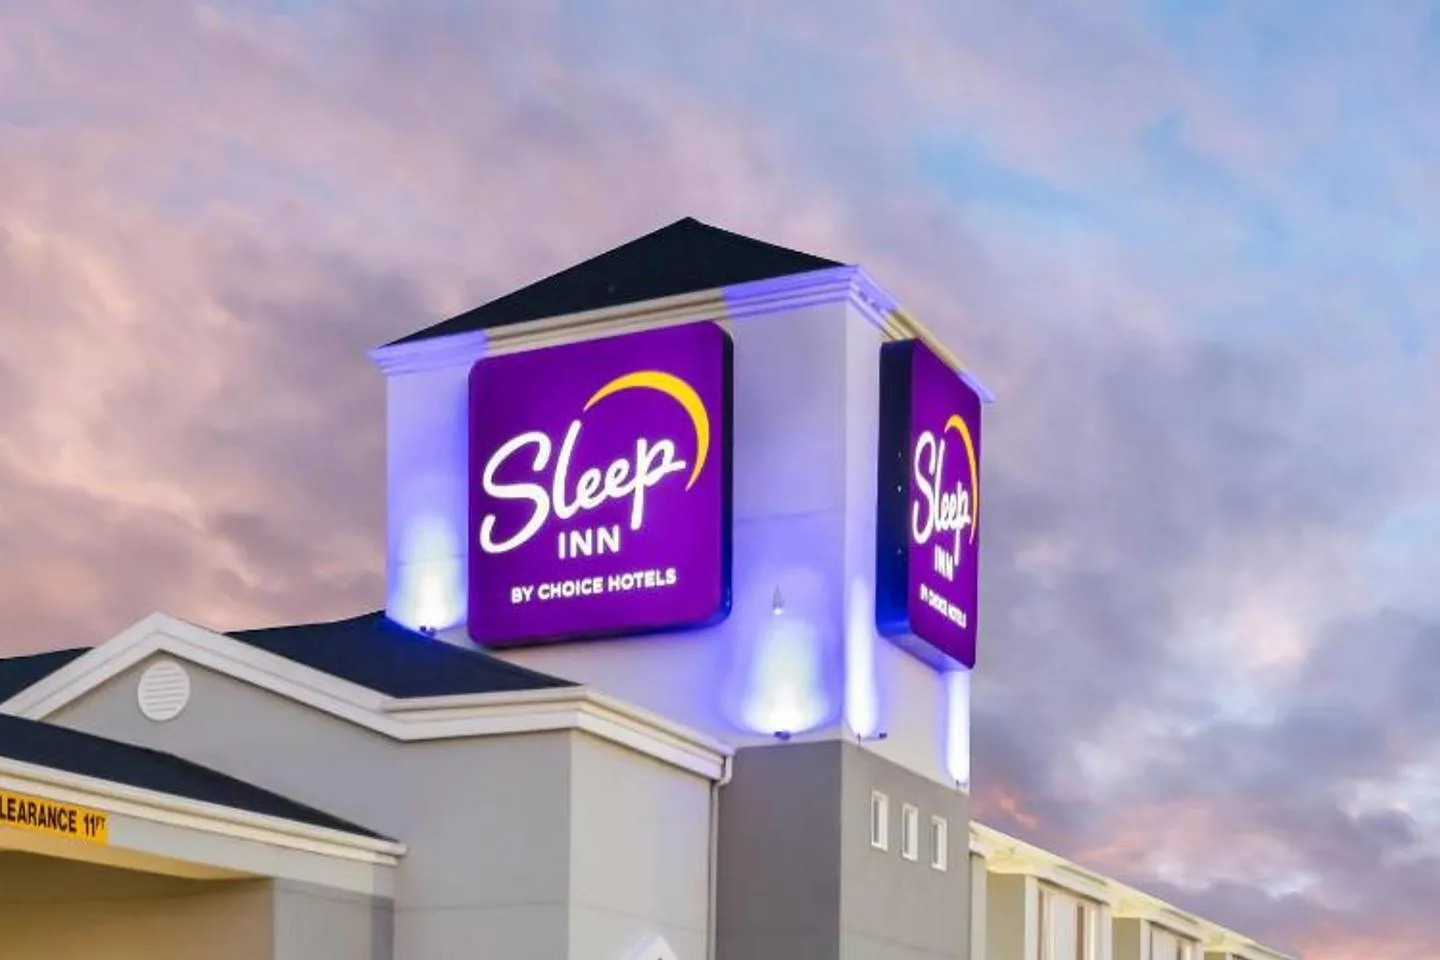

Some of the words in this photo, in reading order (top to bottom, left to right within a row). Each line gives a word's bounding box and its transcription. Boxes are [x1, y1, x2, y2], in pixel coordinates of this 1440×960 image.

[480, 420, 686, 553] Sleep
[912, 431, 971, 566] Sleep
[558, 525, 620, 559] INN
[511, 585, 534, 604] BY
[537, 576, 603, 600] CHOICE
[608, 567, 677, 592] HOTELS
